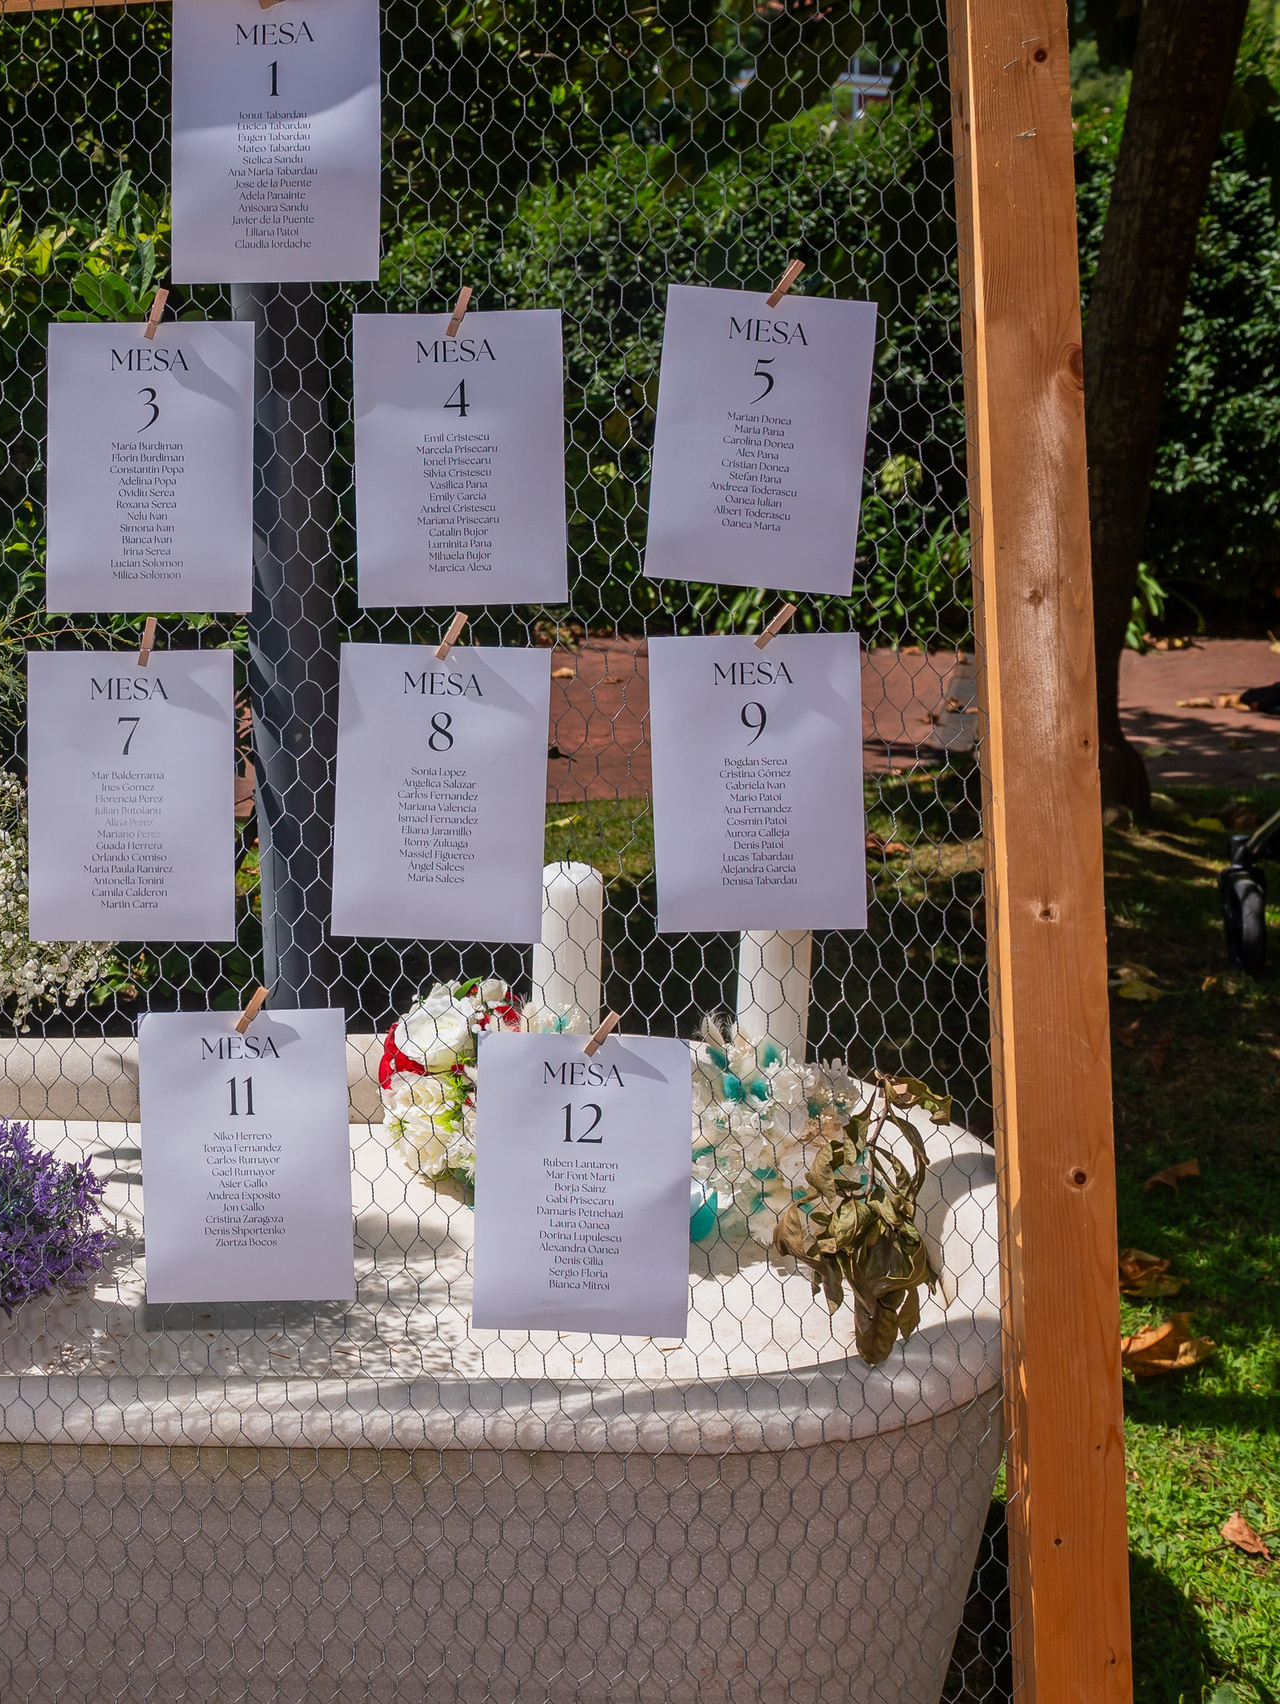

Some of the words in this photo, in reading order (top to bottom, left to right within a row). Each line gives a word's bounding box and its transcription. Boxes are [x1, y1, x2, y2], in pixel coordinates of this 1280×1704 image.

[236, 22, 315, 46] MESA
[267, 60, 281, 97] 1
[238, 110, 262, 119] Ionut
[265, 110, 308, 119] Tabardau
[242, 154, 272, 164] Stelica
[273, 154, 303, 163] Sandu
[234, 178, 254, 191] Jose
[256, 178, 268, 187] de
[270, 178, 278, 187] la
[280, 177, 311, 187] Puente
[238, 190, 265, 200] Adela
[266, 189, 305, 199] Panainte
[234, 239, 269, 249] Claudia
[271, 238, 311, 248] Iordache
[728, 316, 808, 346] MESA
[416, 338, 497, 364] MESA
[110, 348, 190, 372] MESA
[749, 356, 776, 405] 5
[443, 377, 470, 418] 4
[136, 387, 160, 434] 3
[727, 410, 759, 422] Marian
[761, 413, 791, 425] Donea
[424, 432, 444, 442] Emil
[445, 431, 489, 441] Cristescu
[722, 433, 762, 446] Carolina
[763, 437, 794, 449] Donea
[416, 444, 452, 454] Marcela
[454, 443, 497, 453] Prisecaru
[735, 446, 755, 457] Alex
[757, 449, 779, 460] Pana
[112, 452, 138, 461] Florin
[140, 452, 184, 461] Burdiman
[109, 464, 159, 473] Constantin
[161, 464, 184, 476] Popa
[423, 468, 446, 477] Silvia
[448, 467, 491, 477] Cristescu
[728, 470, 758, 481] Stefan
[759, 473, 782, 484] Pana
[429, 479, 463, 489] Vasilica
[465, 479, 487, 488] Pana
[116, 499, 149, 508] Roxana
[151, 499, 176, 508] Serea
[713, 504, 742, 515] Albert
[745, 507, 790, 520] Toderascu
[119, 523, 154, 532] Simona
[156, 522, 174, 531] Ivan
[428, 526, 461, 536] Catalin
[463, 526, 488, 538] Bujor
[428, 538, 468, 548] Luminita
[470, 538, 491, 547] Pana
[110, 558, 140, 567] Lucian
[142, 558, 183, 567] Solomon
[713, 661, 794, 686] MESA
[90, 677, 169, 701] MESA
[403, 671, 484, 697] MESA
[740, 701, 767, 747] 9
[117, 716, 141, 756] 7
[428, 711, 454, 752] 8
[724, 756, 759, 769] Bogdan
[761, 756, 787, 765] Serea
[91, 770, 109, 779] Mar
[111, 770, 164, 779] Balderrama
[411, 765, 437, 775] Sonia
[438, 766, 466, 779] Lopez
[719, 768, 755, 778] Cristina
[757, 767, 791, 777] Gómez
[725, 780, 764, 790] Gabriela
[766, 779, 785, 789] Ivan
[397, 789, 428, 799] Carlos
[430, 790, 478, 801] Fernandez
[398, 801, 435, 811] Mariana
[437, 802, 476, 812] Valencia
[398, 812, 427, 822] Ismael
[430, 814, 478, 824] Fernandez
[726, 816, 762, 825] Cosmin
[764, 815, 787, 825] Patoi
[95, 840, 125, 849] Guada
[127, 840, 162, 849] Herrera
[404, 836, 431, 849] Romy
[432, 837, 468, 851] Zuluaga
[733, 839, 759, 849] Denis
[761, 839, 783, 849] Patoi
[91, 852, 129, 861] Orlando
[131, 852, 166, 861] Comiso
[722, 852, 749, 861] Lucas
[752, 851, 793, 861] Tabardau
[92, 875, 135, 884] Antonella
[138, 875, 164, 884] Tonini
[91, 887, 123, 896] Camila
[125, 887, 167, 896] Calderon
[201, 1035, 281, 1061] MESA
[543, 1061, 625, 1088] MESA
[225, 1076, 256, 1116] 11
[561, 1102, 604, 1144] 12
[213, 1131, 233, 1140] Niko
[235, 1130, 272, 1140] Herrero
[206, 1154, 236, 1164] Carlos
[238, 1154, 280, 1166] Rumayor
[543, 1157, 573, 1167] Ruben
[575, 1158, 618, 1169] Lantaron
[211, 1167, 232, 1176] Gael
[234, 1166, 276, 1178] Rumayor
[554, 1181, 579, 1194] Borja
[581, 1182, 606, 1193] Sainz
[222, 1202, 238, 1214] Jon
[240, 1202, 264, 1211] Gallo
[205, 1214, 241, 1223] Cristina
[243, 1213, 283, 1225] Zaragoza
[549, 1217, 576, 1228] Laura
[578, 1219, 609, 1230] Oanea
[539, 1229, 571, 1240] Dorina
[573, 1231, 621, 1245] Lupulescu
[554, 1254, 580, 1264] Denis
[582, 1255, 603, 1266] Gilia
